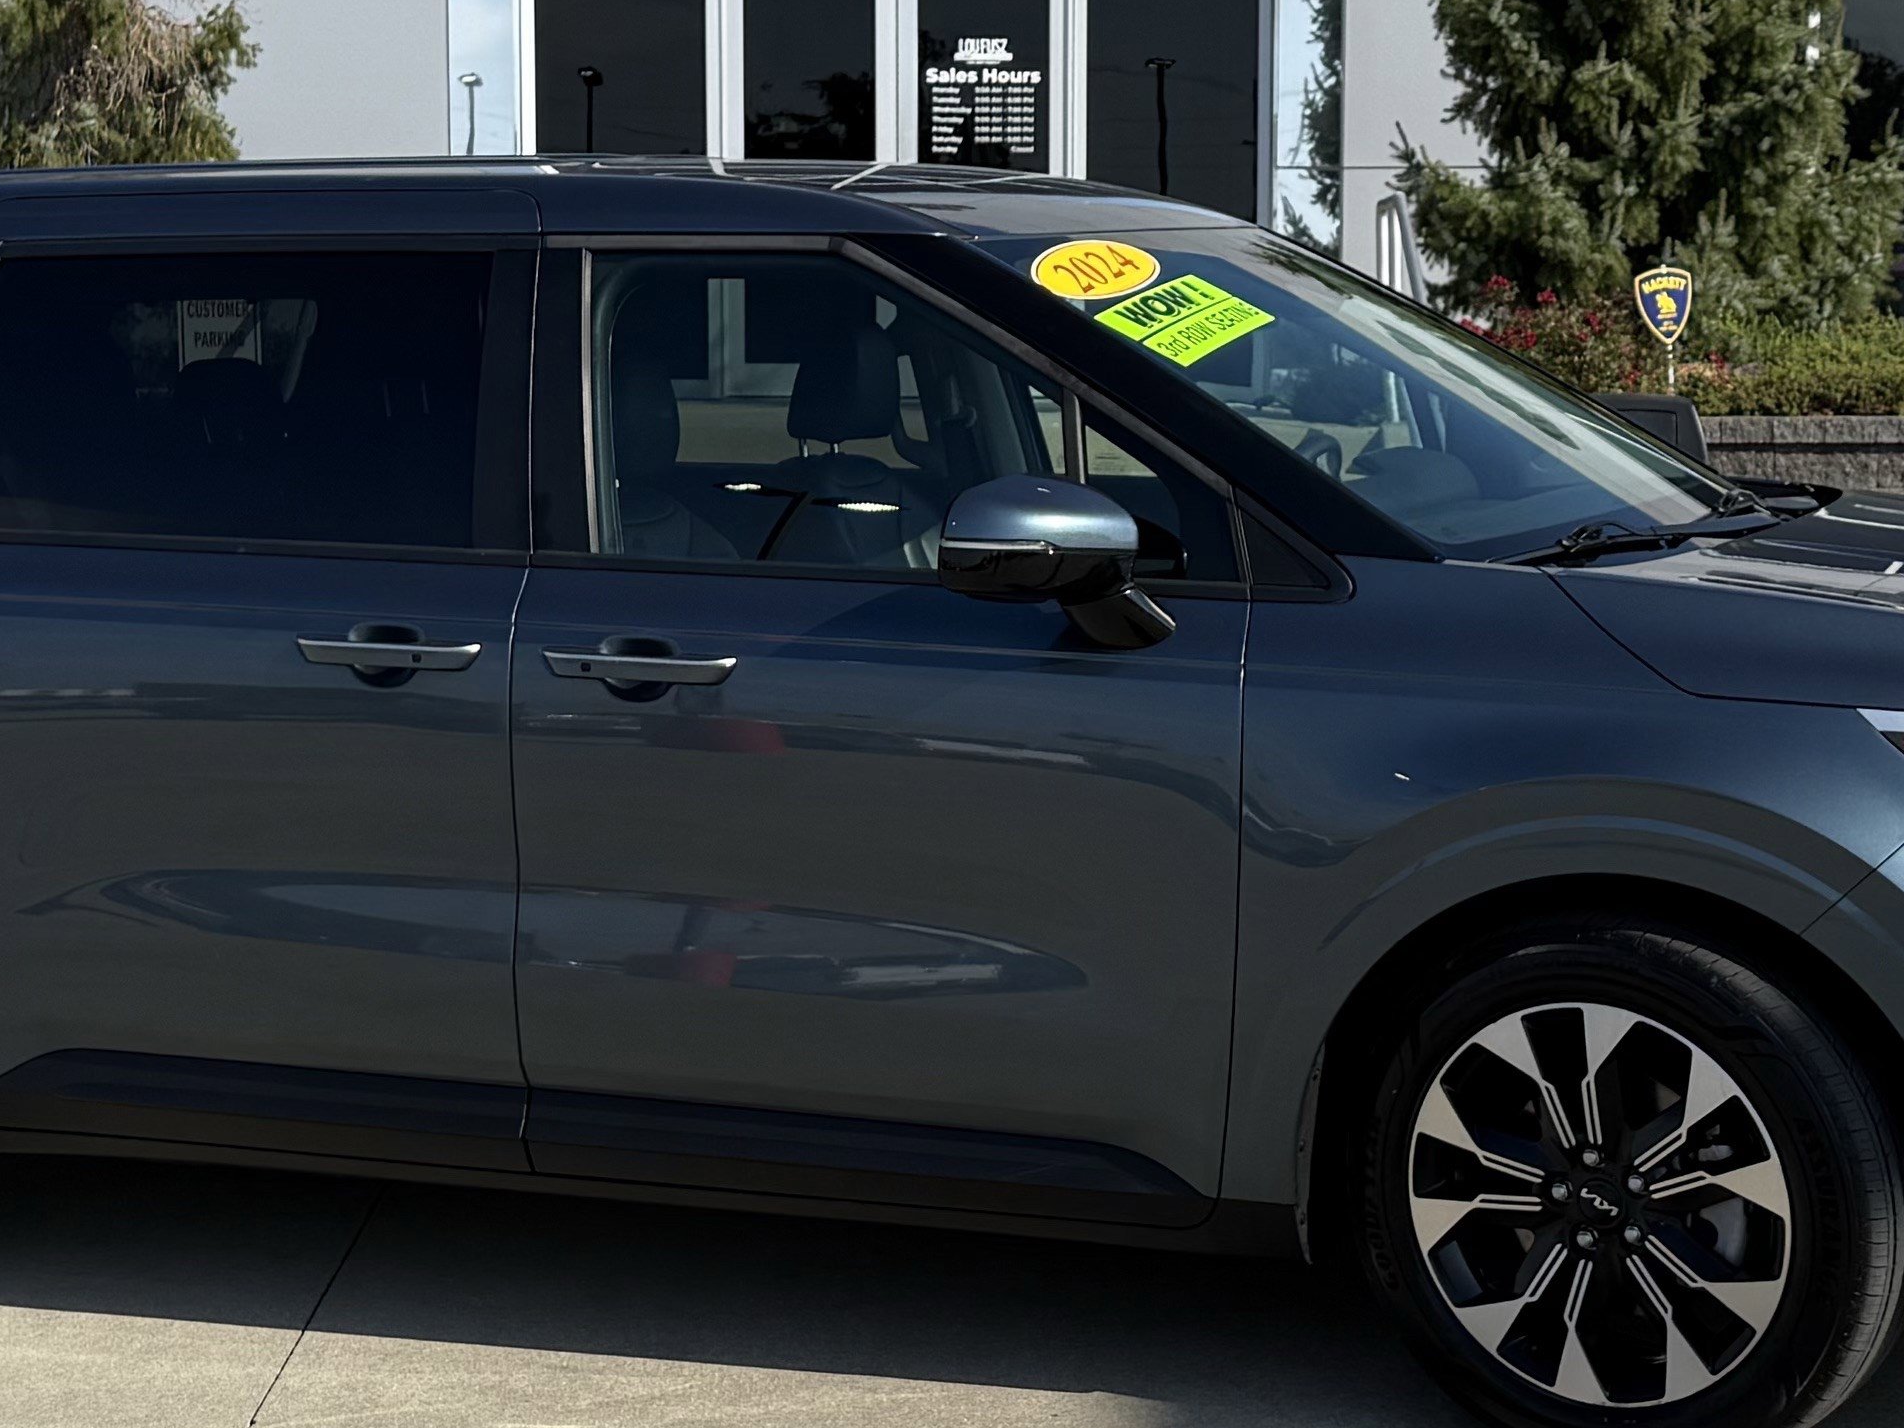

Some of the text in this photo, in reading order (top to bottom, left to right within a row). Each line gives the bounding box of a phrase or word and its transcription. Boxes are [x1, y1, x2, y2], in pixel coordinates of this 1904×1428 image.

[925, 67, 1042, 84] Sales Hours
[1053, 245, 1141, 294] 2024
[1177, 320, 1217, 346] ROW
